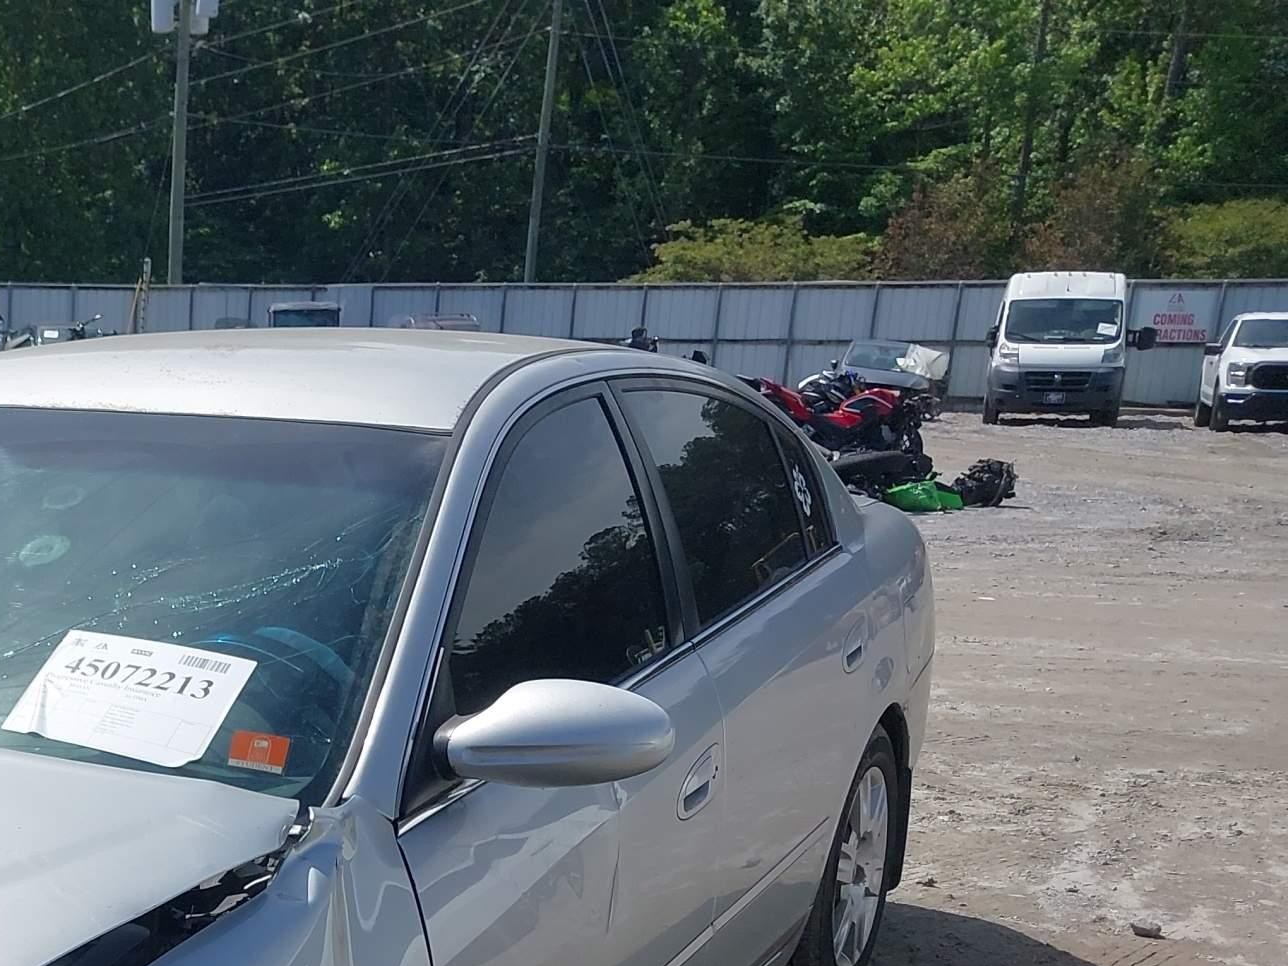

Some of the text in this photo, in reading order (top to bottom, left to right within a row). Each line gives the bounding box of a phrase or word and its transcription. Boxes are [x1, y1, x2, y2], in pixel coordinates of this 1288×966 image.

[1153, 313, 1194, 326] COMING
[1156, 328, 1207, 341] RACTIONS
[64, 656, 214, 699] 45072213
